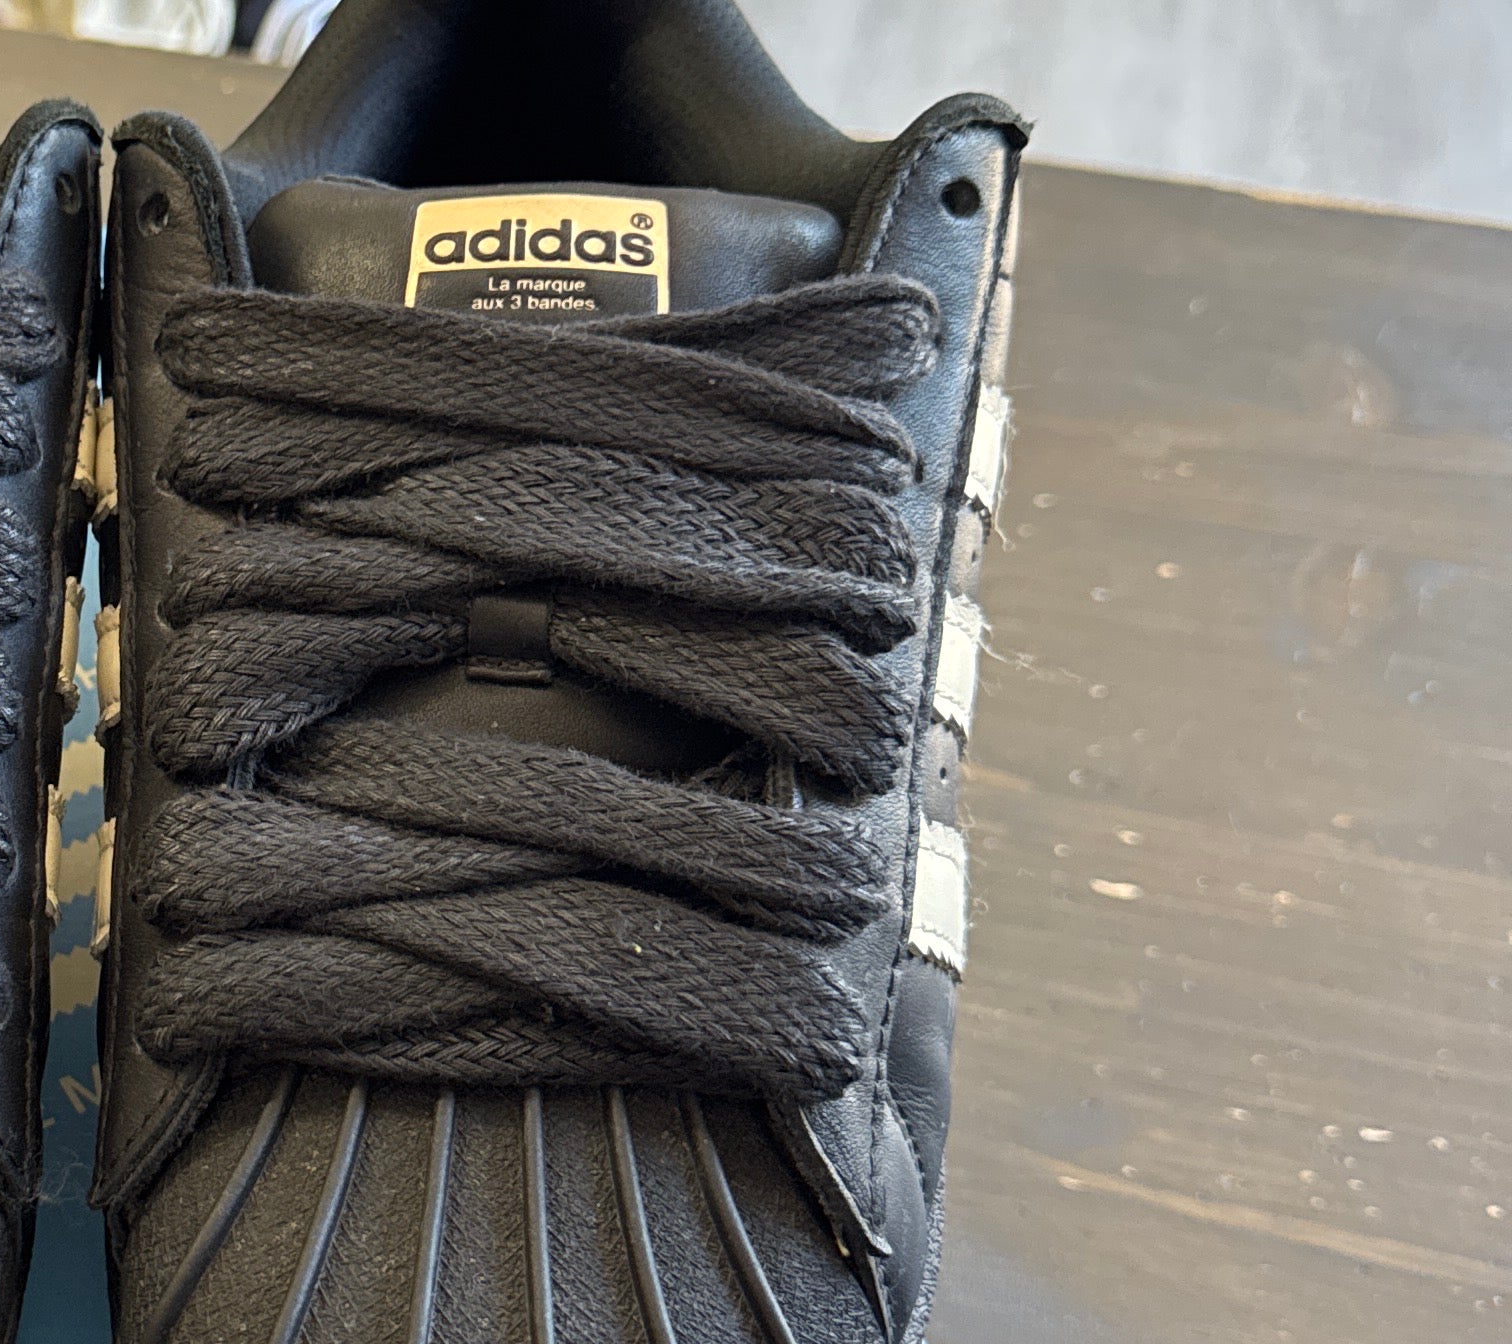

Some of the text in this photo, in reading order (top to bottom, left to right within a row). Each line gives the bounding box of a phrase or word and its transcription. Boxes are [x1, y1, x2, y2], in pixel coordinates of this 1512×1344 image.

[425, 219, 655, 267] adidas
[488, 276, 586, 296] La marque
[471, 297, 505, 311] aux
[510, 295, 522, 310] 3
